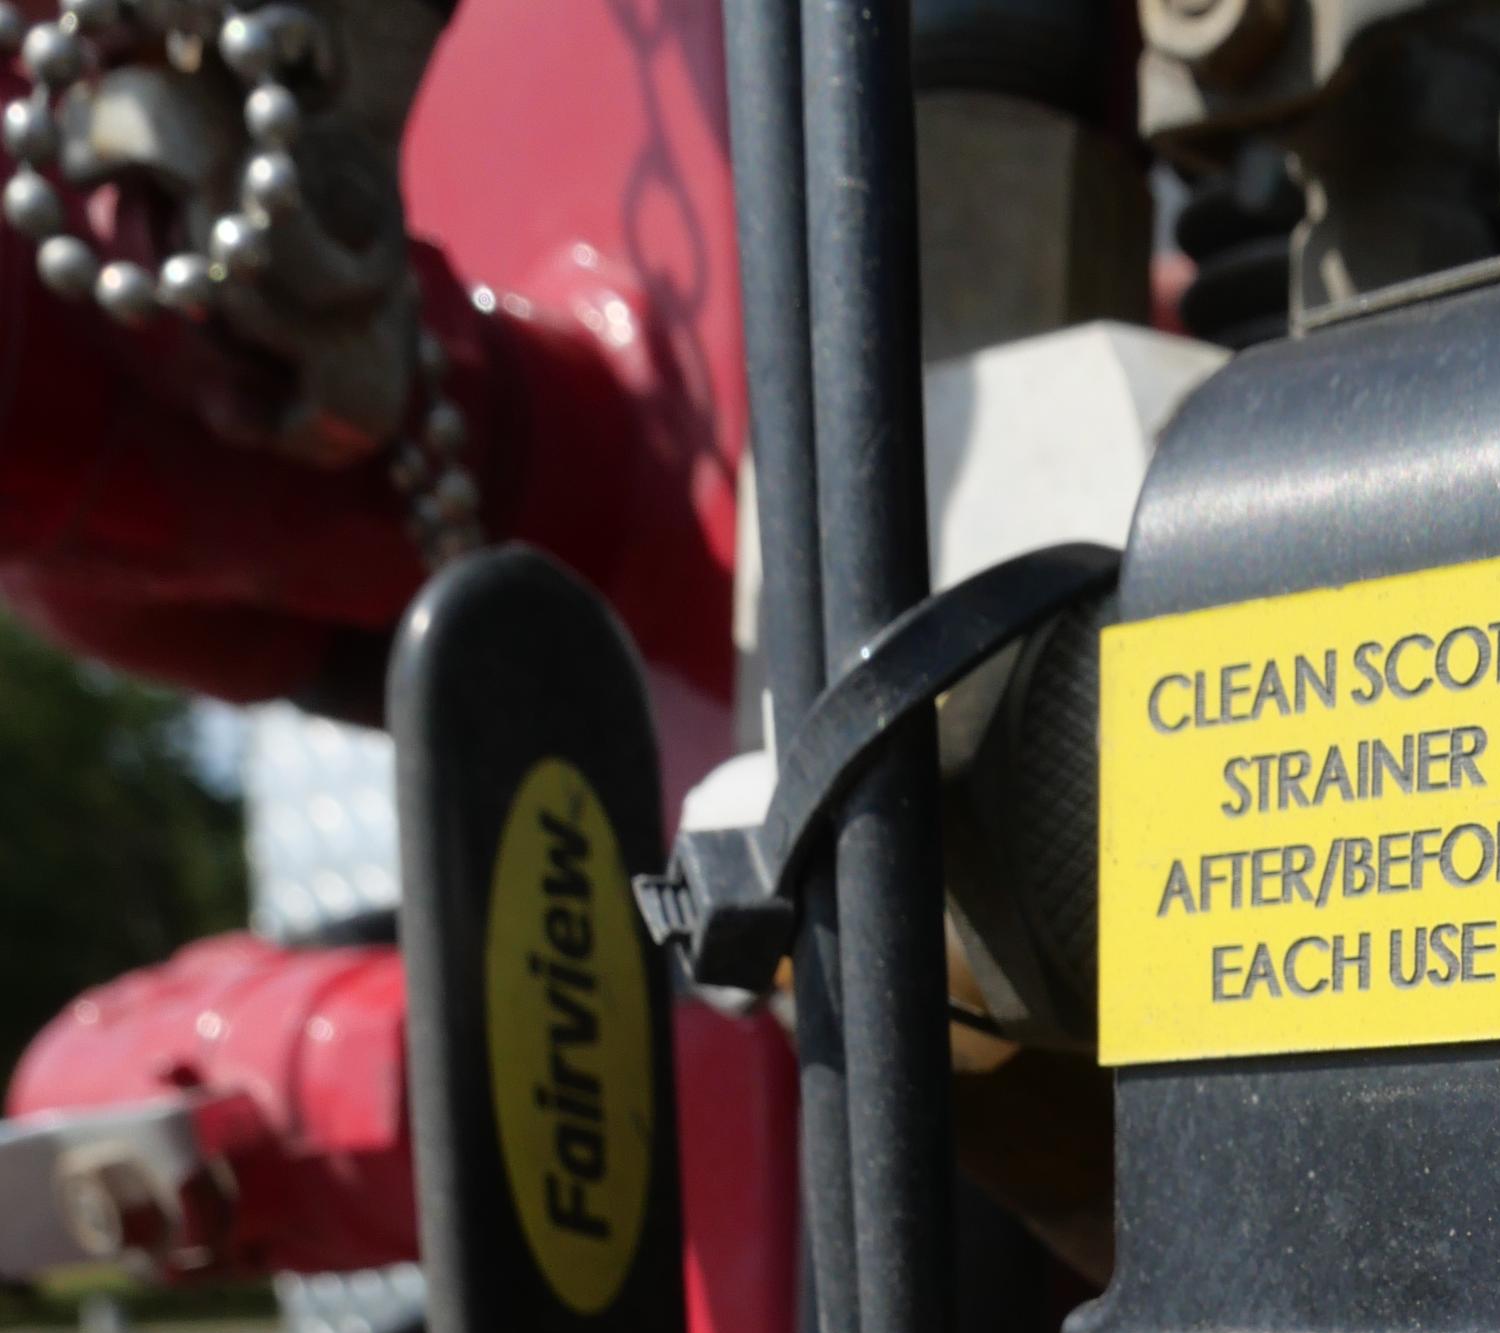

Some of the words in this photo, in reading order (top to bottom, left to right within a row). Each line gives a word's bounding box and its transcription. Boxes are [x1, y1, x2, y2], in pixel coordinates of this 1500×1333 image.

[1146, 647, 1337, 735] CLEAN
[1221, 725, 1487, 818] STRAINER
[1211, 931, 1371, 1003] EACH
[1388, 920, 1498, 988] USE
[527, 808, 612, 1242] Fairview
